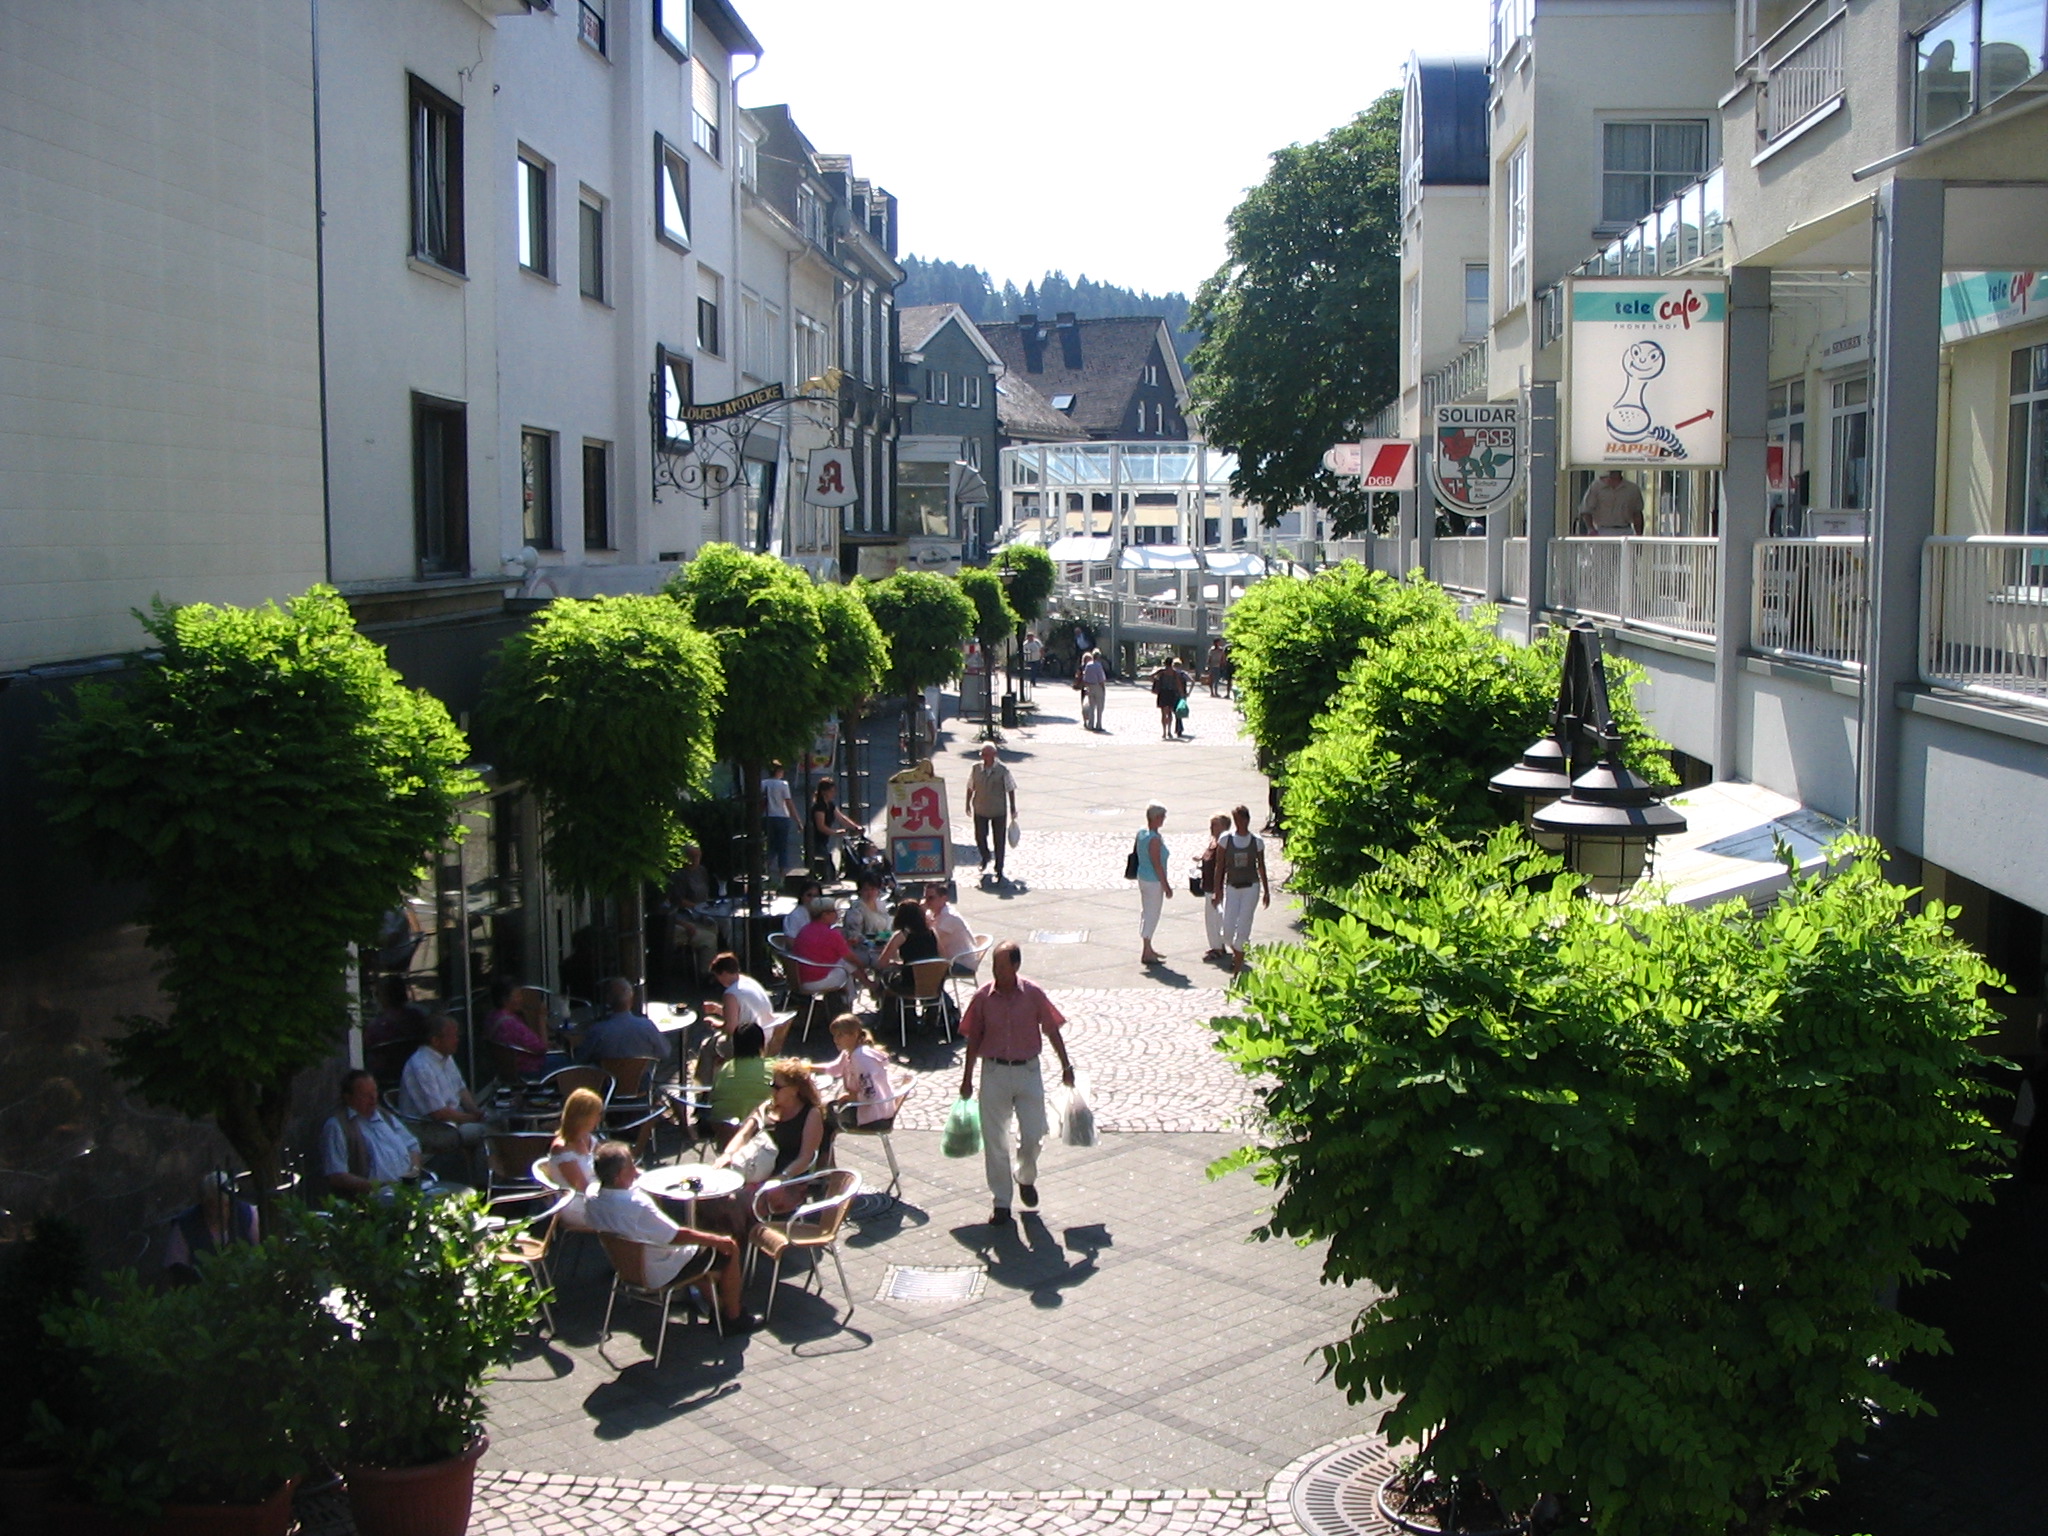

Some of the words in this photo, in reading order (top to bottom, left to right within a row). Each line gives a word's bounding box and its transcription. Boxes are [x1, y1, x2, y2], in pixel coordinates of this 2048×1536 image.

[1614, 300, 1650, 314] tele
[1659, 288, 1701, 330] cafe
[1438, 408, 1516, 422] SOLIDAR
[1474, 428, 1514, 448] ASB
[1368, 476, 1393, 486] DGB
